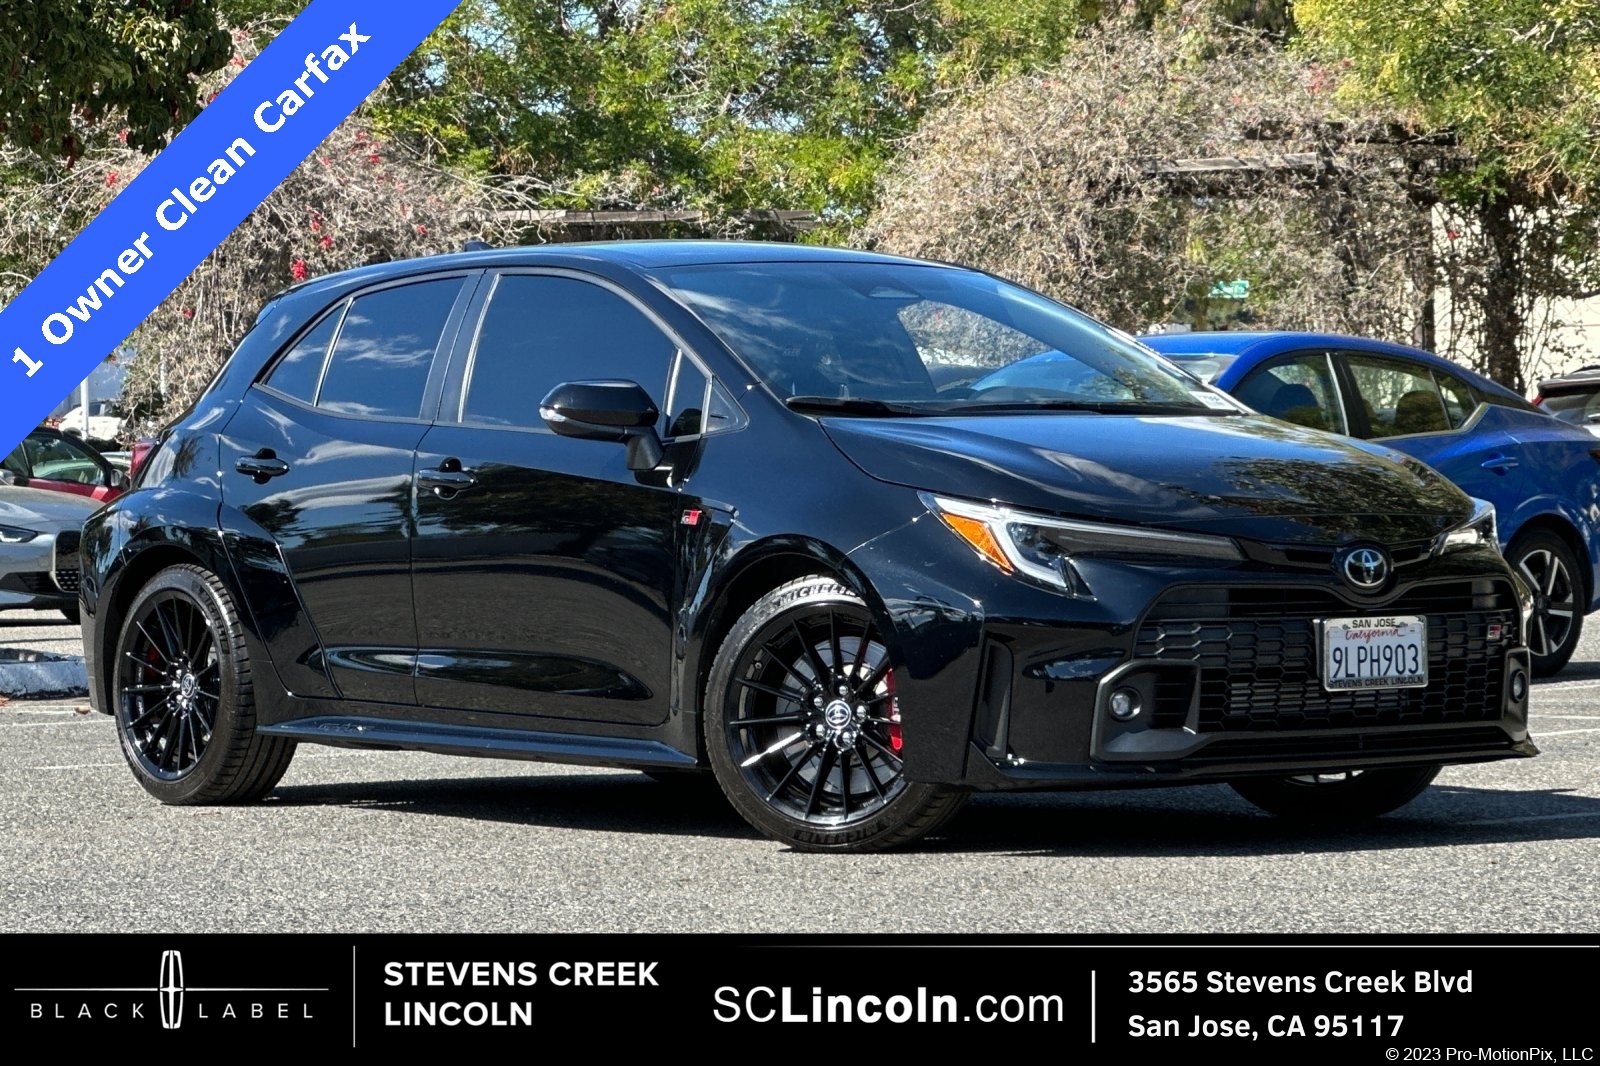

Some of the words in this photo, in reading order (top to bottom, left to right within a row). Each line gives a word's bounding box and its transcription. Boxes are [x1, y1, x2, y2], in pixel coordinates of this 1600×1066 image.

[1352, 619, 1371, 629] SAN
[1374, 618, 1396, 628] JOSE
[1345, 628, 1405, 643] California
[1332, 643, 1419, 679] 9LPH903
[1329, 678, 1363, 689] STEVENS
[1365, 677, 1389, 687] CREEK
[1391, 676, 1424, 686] LINCOLN
